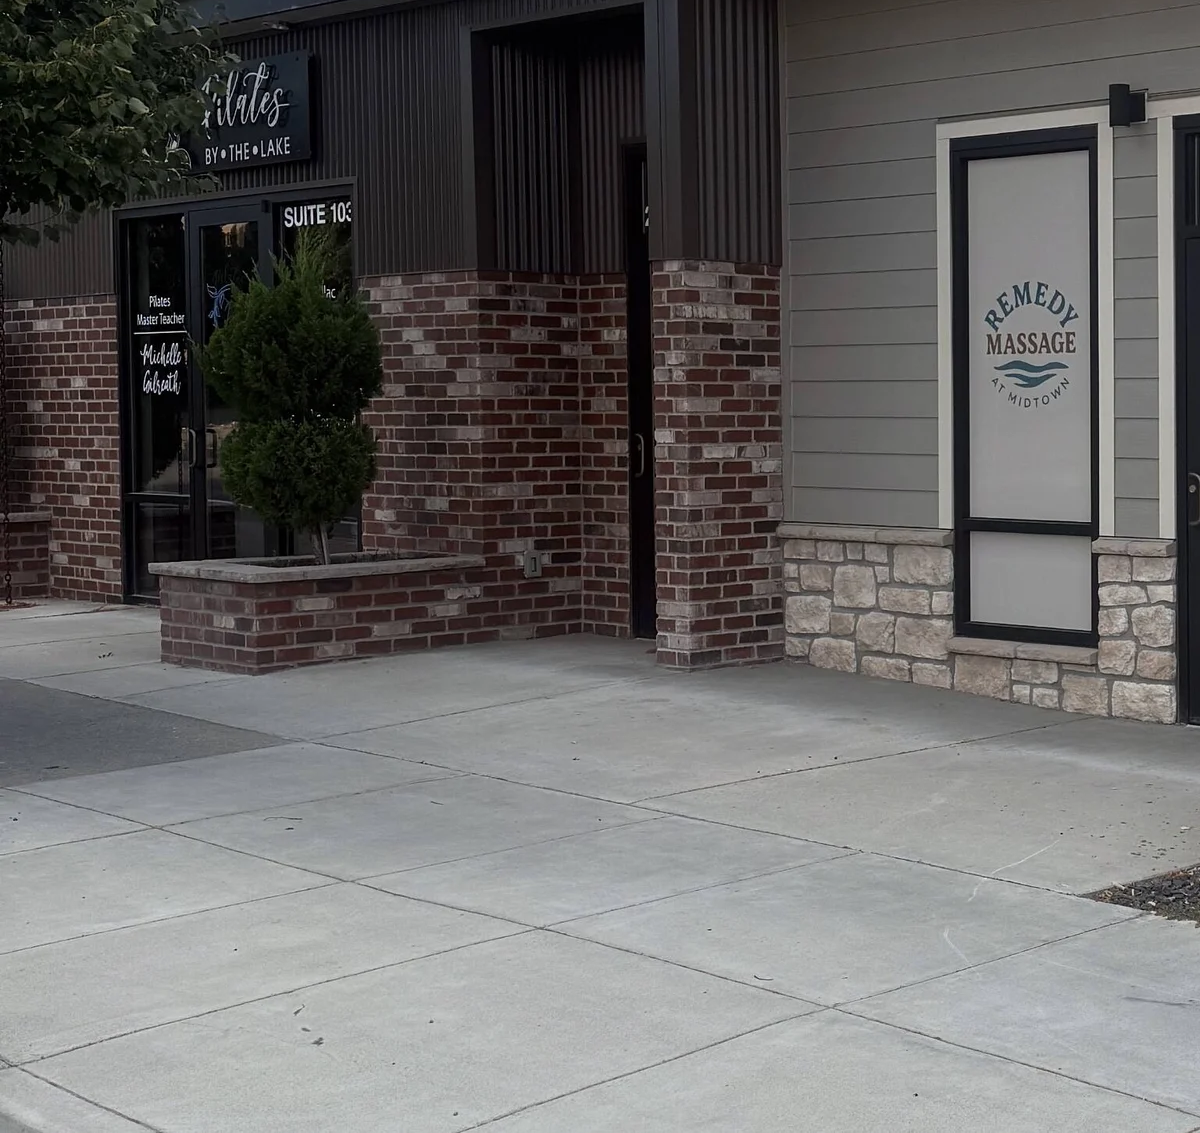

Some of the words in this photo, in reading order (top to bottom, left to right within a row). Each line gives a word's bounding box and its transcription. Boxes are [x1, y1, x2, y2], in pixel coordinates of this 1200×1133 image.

[284, 203, 326, 228] SUITE
[149, 295, 171, 308] Pilates
[984, 281, 1079, 332] REMEDY
[136, 313, 159, 326] Master
[159, 312, 185, 325] Teacher
[140, 343, 182, 367] Michelle
[986, 331, 1076, 355] MASSAGE
[992, 377, 1006, 393] AT
[1007, 377, 1070, 408] MIDTOWN
